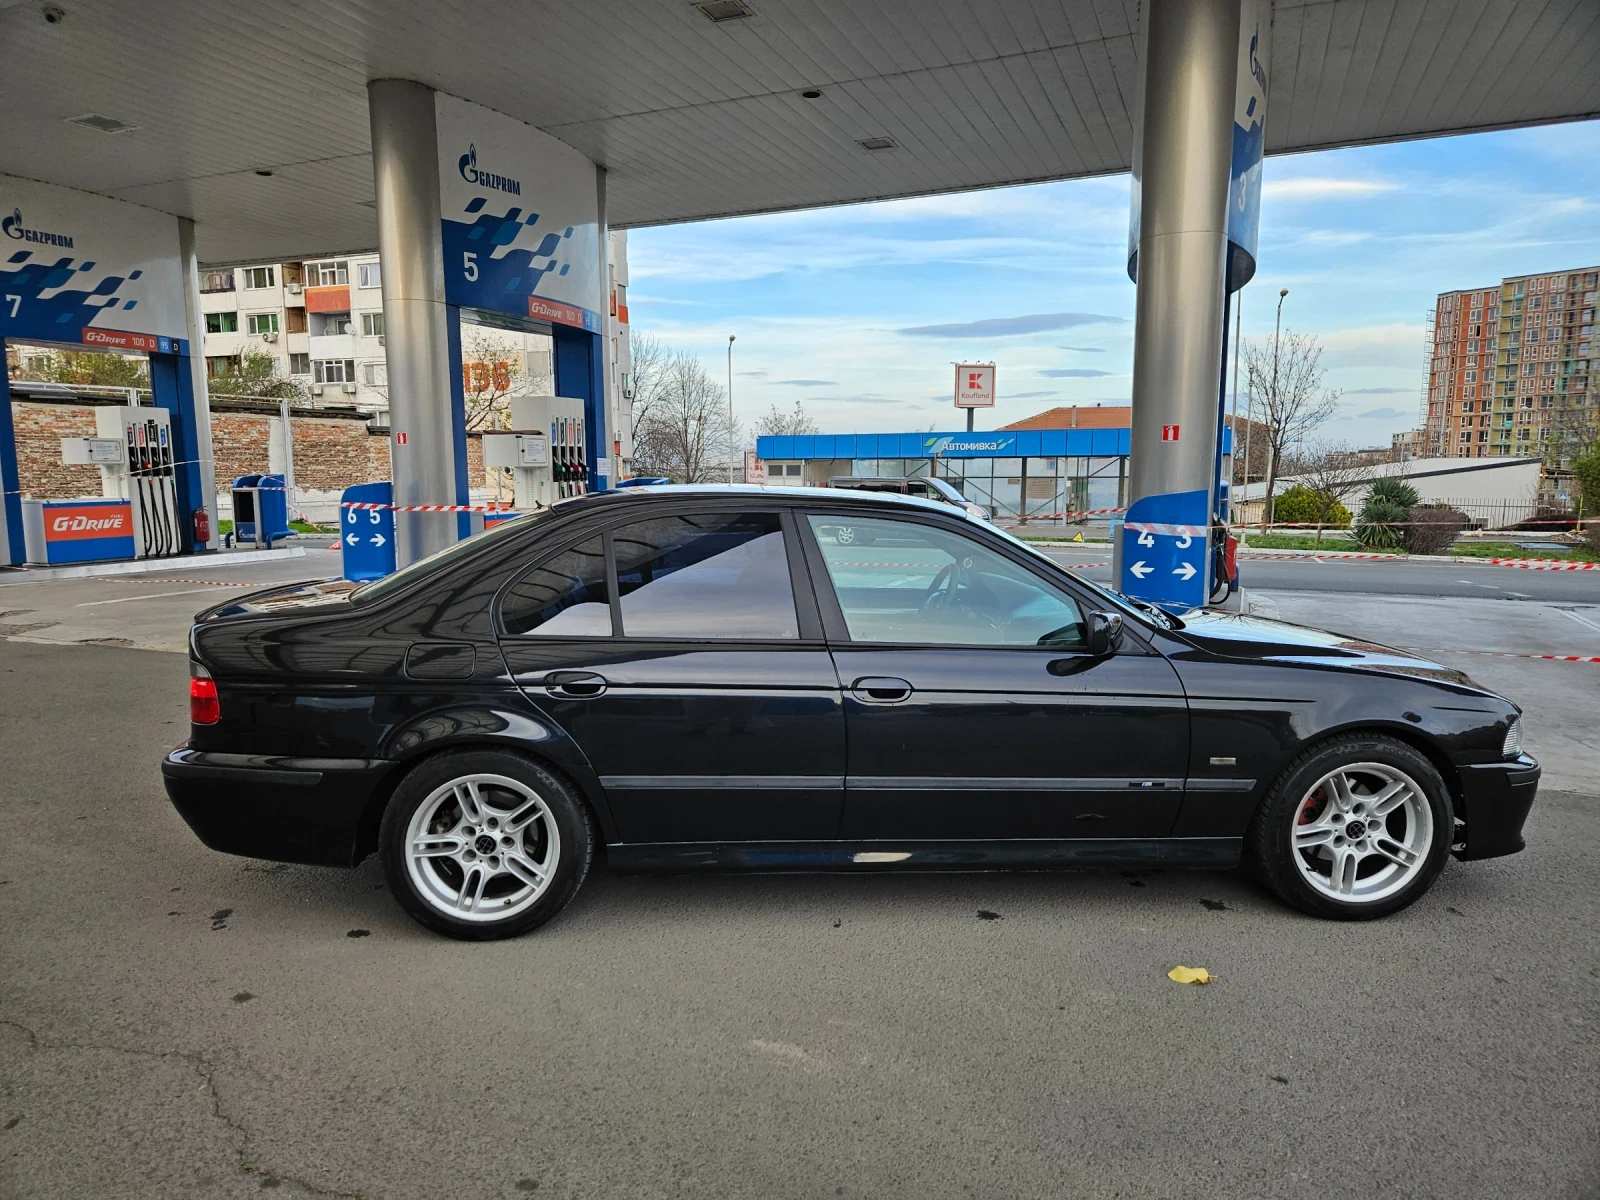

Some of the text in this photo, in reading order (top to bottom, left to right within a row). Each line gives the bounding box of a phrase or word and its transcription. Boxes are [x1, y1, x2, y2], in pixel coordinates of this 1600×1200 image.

[479, 171, 521, 196] GAZPROM
[1238, 171, 1247, 212] 3
[25, 229, 74, 249] GAZPROM
[463, 251, 479, 282] 5
[5, 294, 22, 318] 7
[566, 310, 576, 322] 100
[577, 313, 582, 323] D
[132, 337, 145, 347] 100
[149, 339, 155, 348] D
[160, 341, 169, 349] 95
[173, 343, 179, 351] D
[968, 373, 983, 389] K
[941, 440, 997, 451] Автомивка
[347, 505, 381, 525] 6 5
[1137, 527, 1192, 549] 4 3
